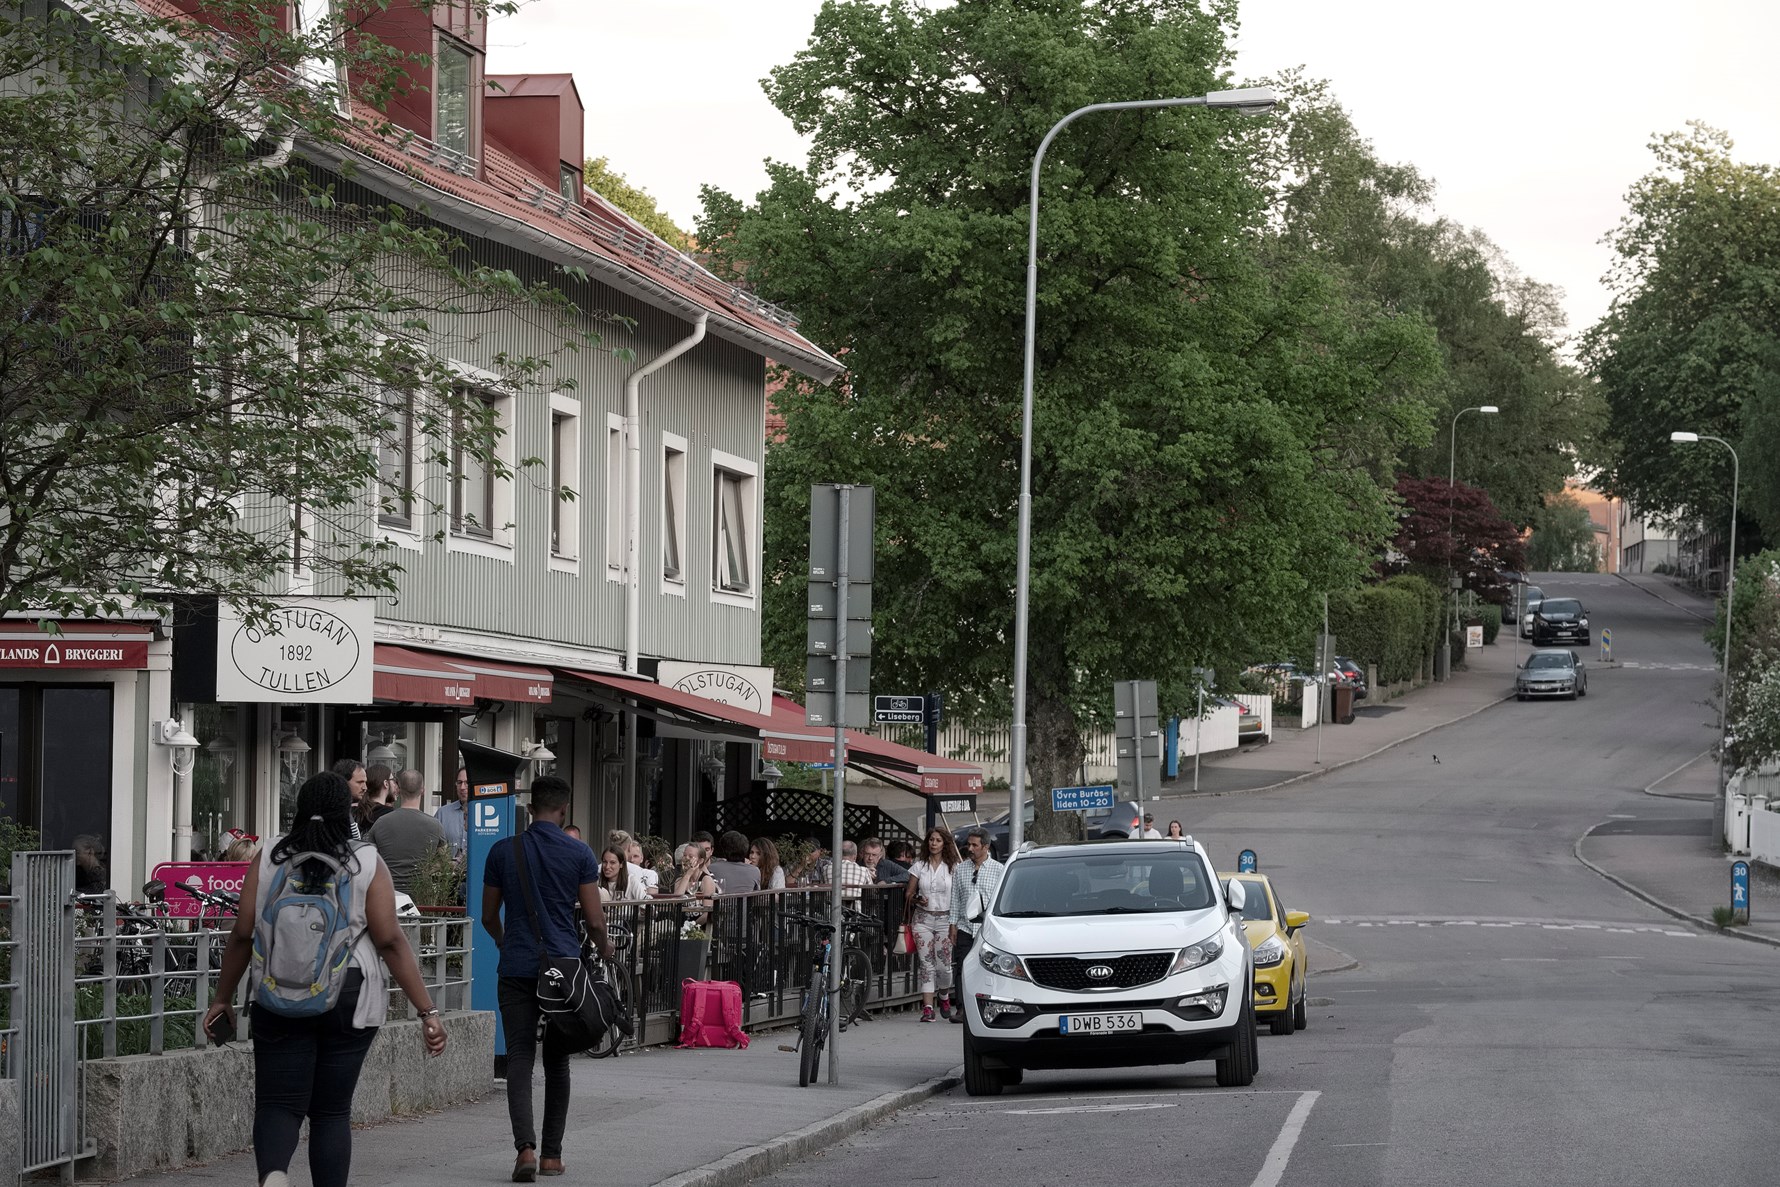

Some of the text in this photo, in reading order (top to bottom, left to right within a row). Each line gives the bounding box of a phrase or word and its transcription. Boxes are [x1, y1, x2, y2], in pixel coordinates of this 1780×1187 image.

[0, 648, 124, 660] LANDS BRYGGERI
[279, 644, 313, 661] 1892
[259, 666, 331, 691] TULLEN
[887, 713, 920, 721] Liseberg
[1056, 790, 1078, 799] Övre
[1056, 798, 1108, 808] liden 10-20
[1241, 855, 1254, 865] 30
[1734, 867, 1747, 876] 30
[1090, 968, 1109, 977] KIA
[1073, 1015, 1136, 1031] DWB 536
